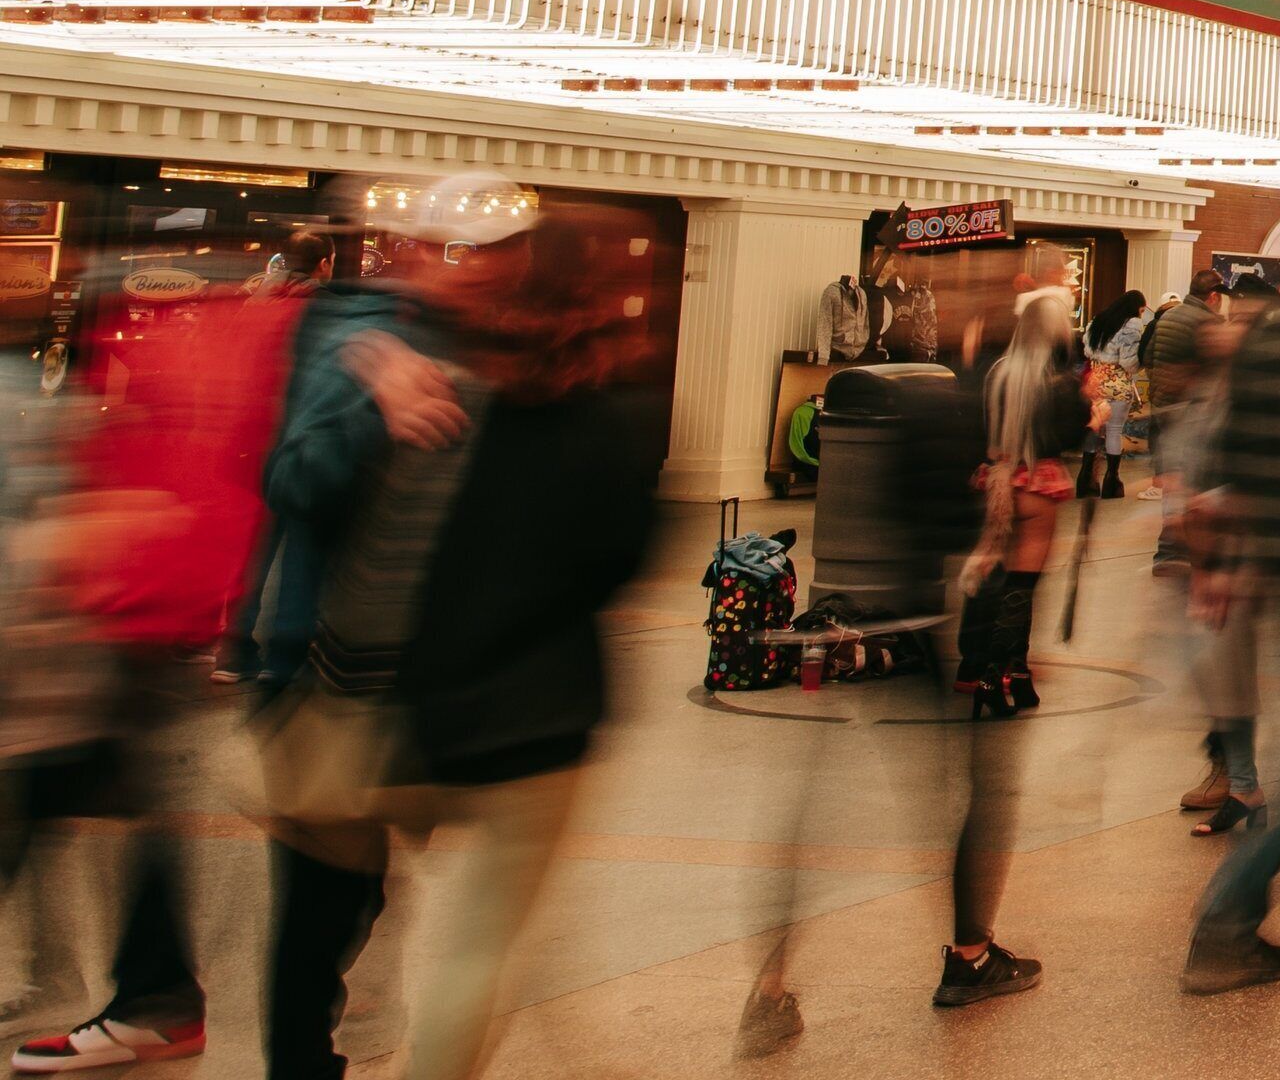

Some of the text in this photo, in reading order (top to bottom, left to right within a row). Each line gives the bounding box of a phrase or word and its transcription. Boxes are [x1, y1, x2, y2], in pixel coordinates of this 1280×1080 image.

[906, 208, 1000, 240] 80% OFF
[0, 276, 46, 290] nion's
[131, 276, 196, 292] Binion's
